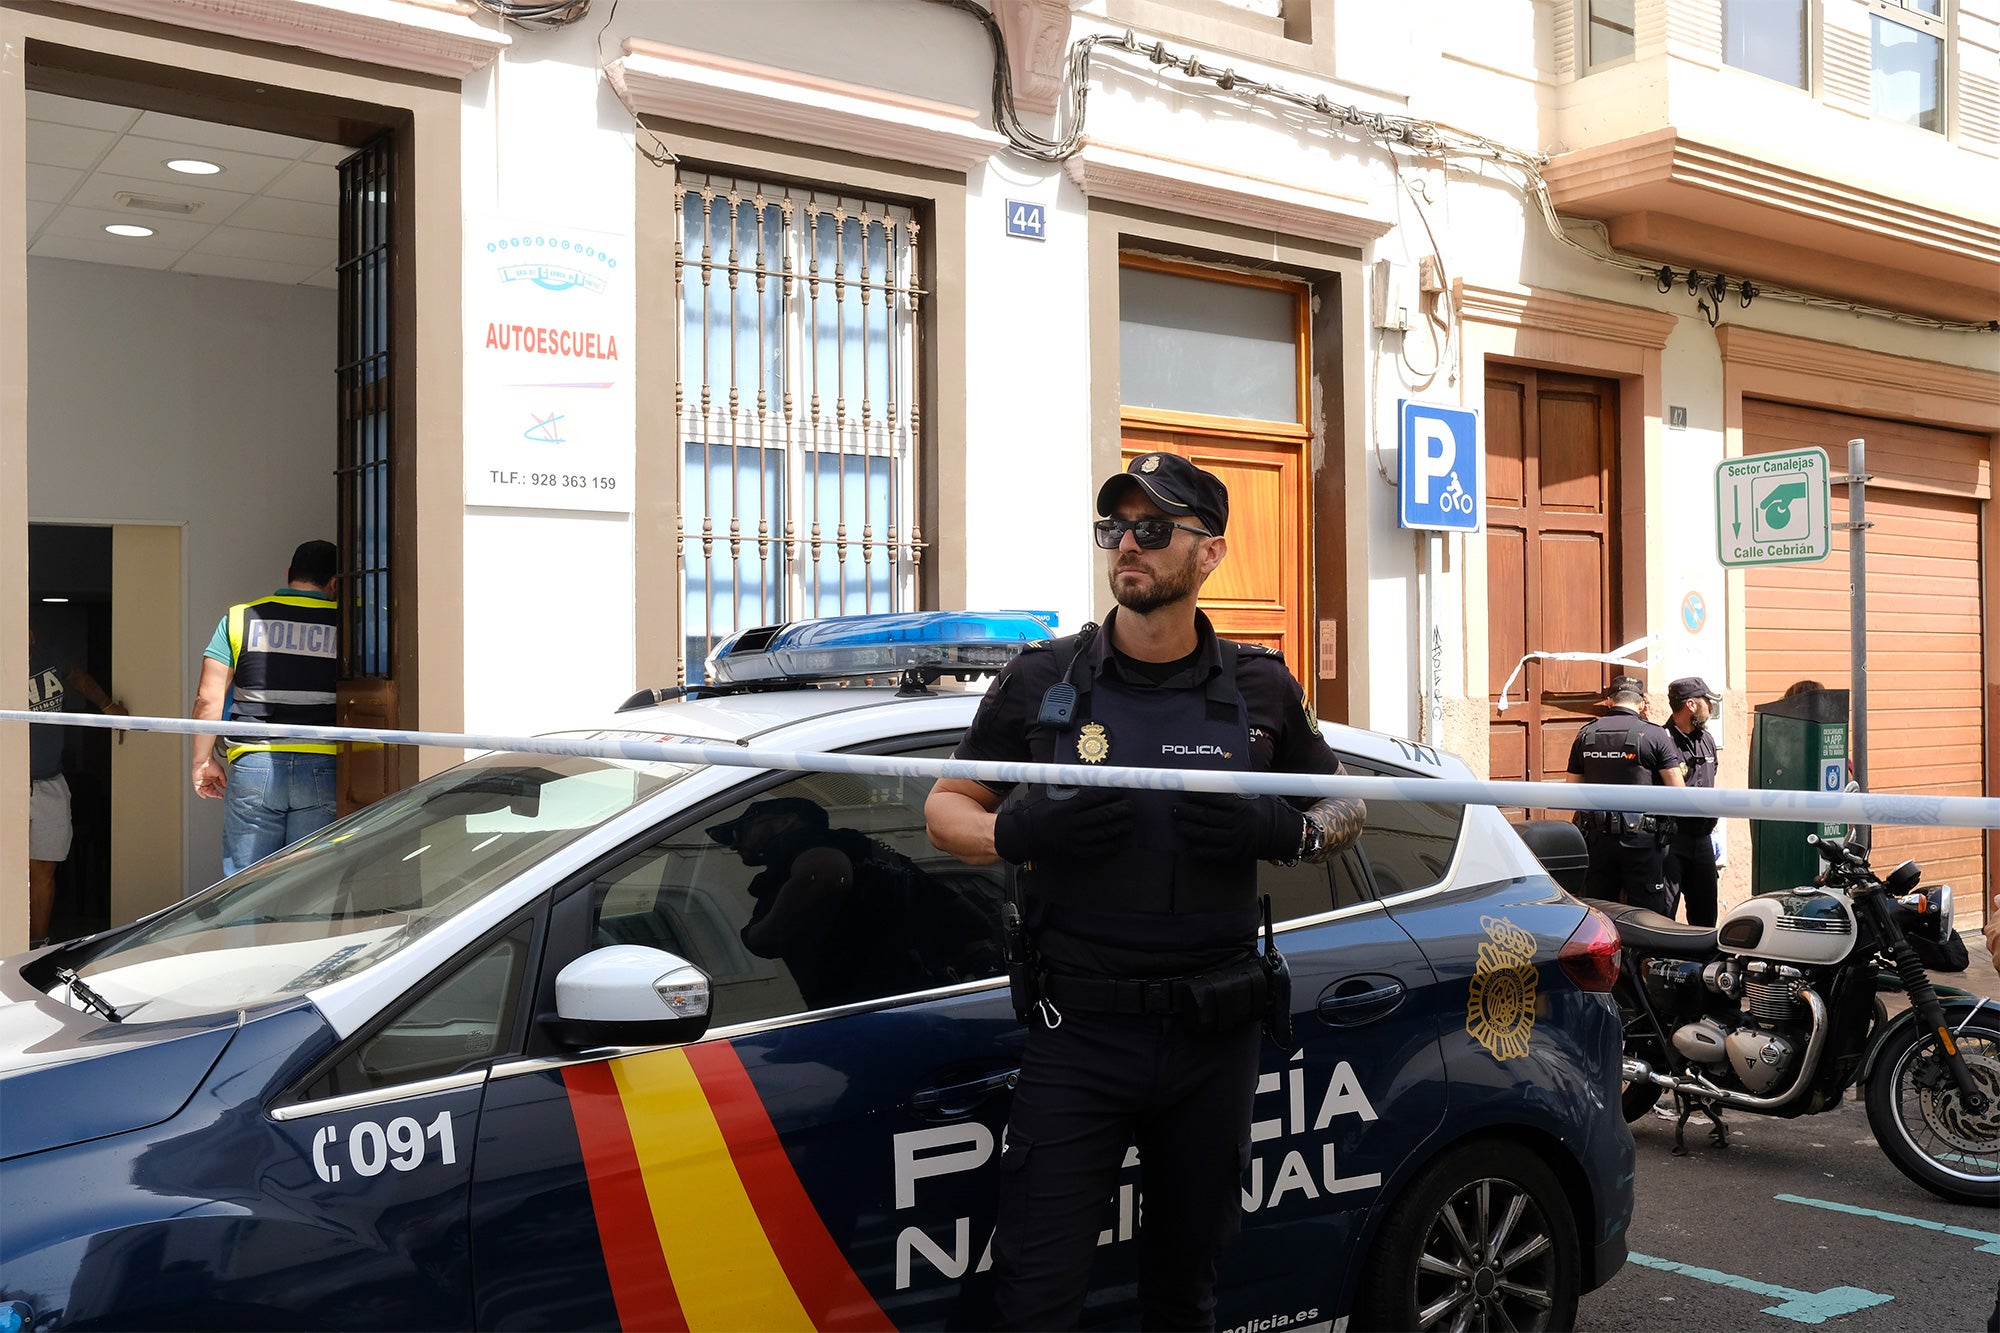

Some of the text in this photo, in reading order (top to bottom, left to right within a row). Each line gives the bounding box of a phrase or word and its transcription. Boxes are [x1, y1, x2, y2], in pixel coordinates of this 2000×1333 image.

[1012, 205, 1042, 234] 44
[485, 322, 618, 361] AUTOESCUELA
[1673, 409, 1683, 427] 42
[1414, 416, 1457, 505] P
[1728, 457, 1814, 477] Sector Canalejas
[490, 470, 616, 490] TLF.: 928 363 159
[1734, 543, 1814, 559] Calle Cebrián
[1161, 744, 1223, 755] POLICIA
[1830, 735, 1842, 744] APP
[1583, 751, 1628, 759] POLICIA
[348, 1110, 456, 1177] 091
